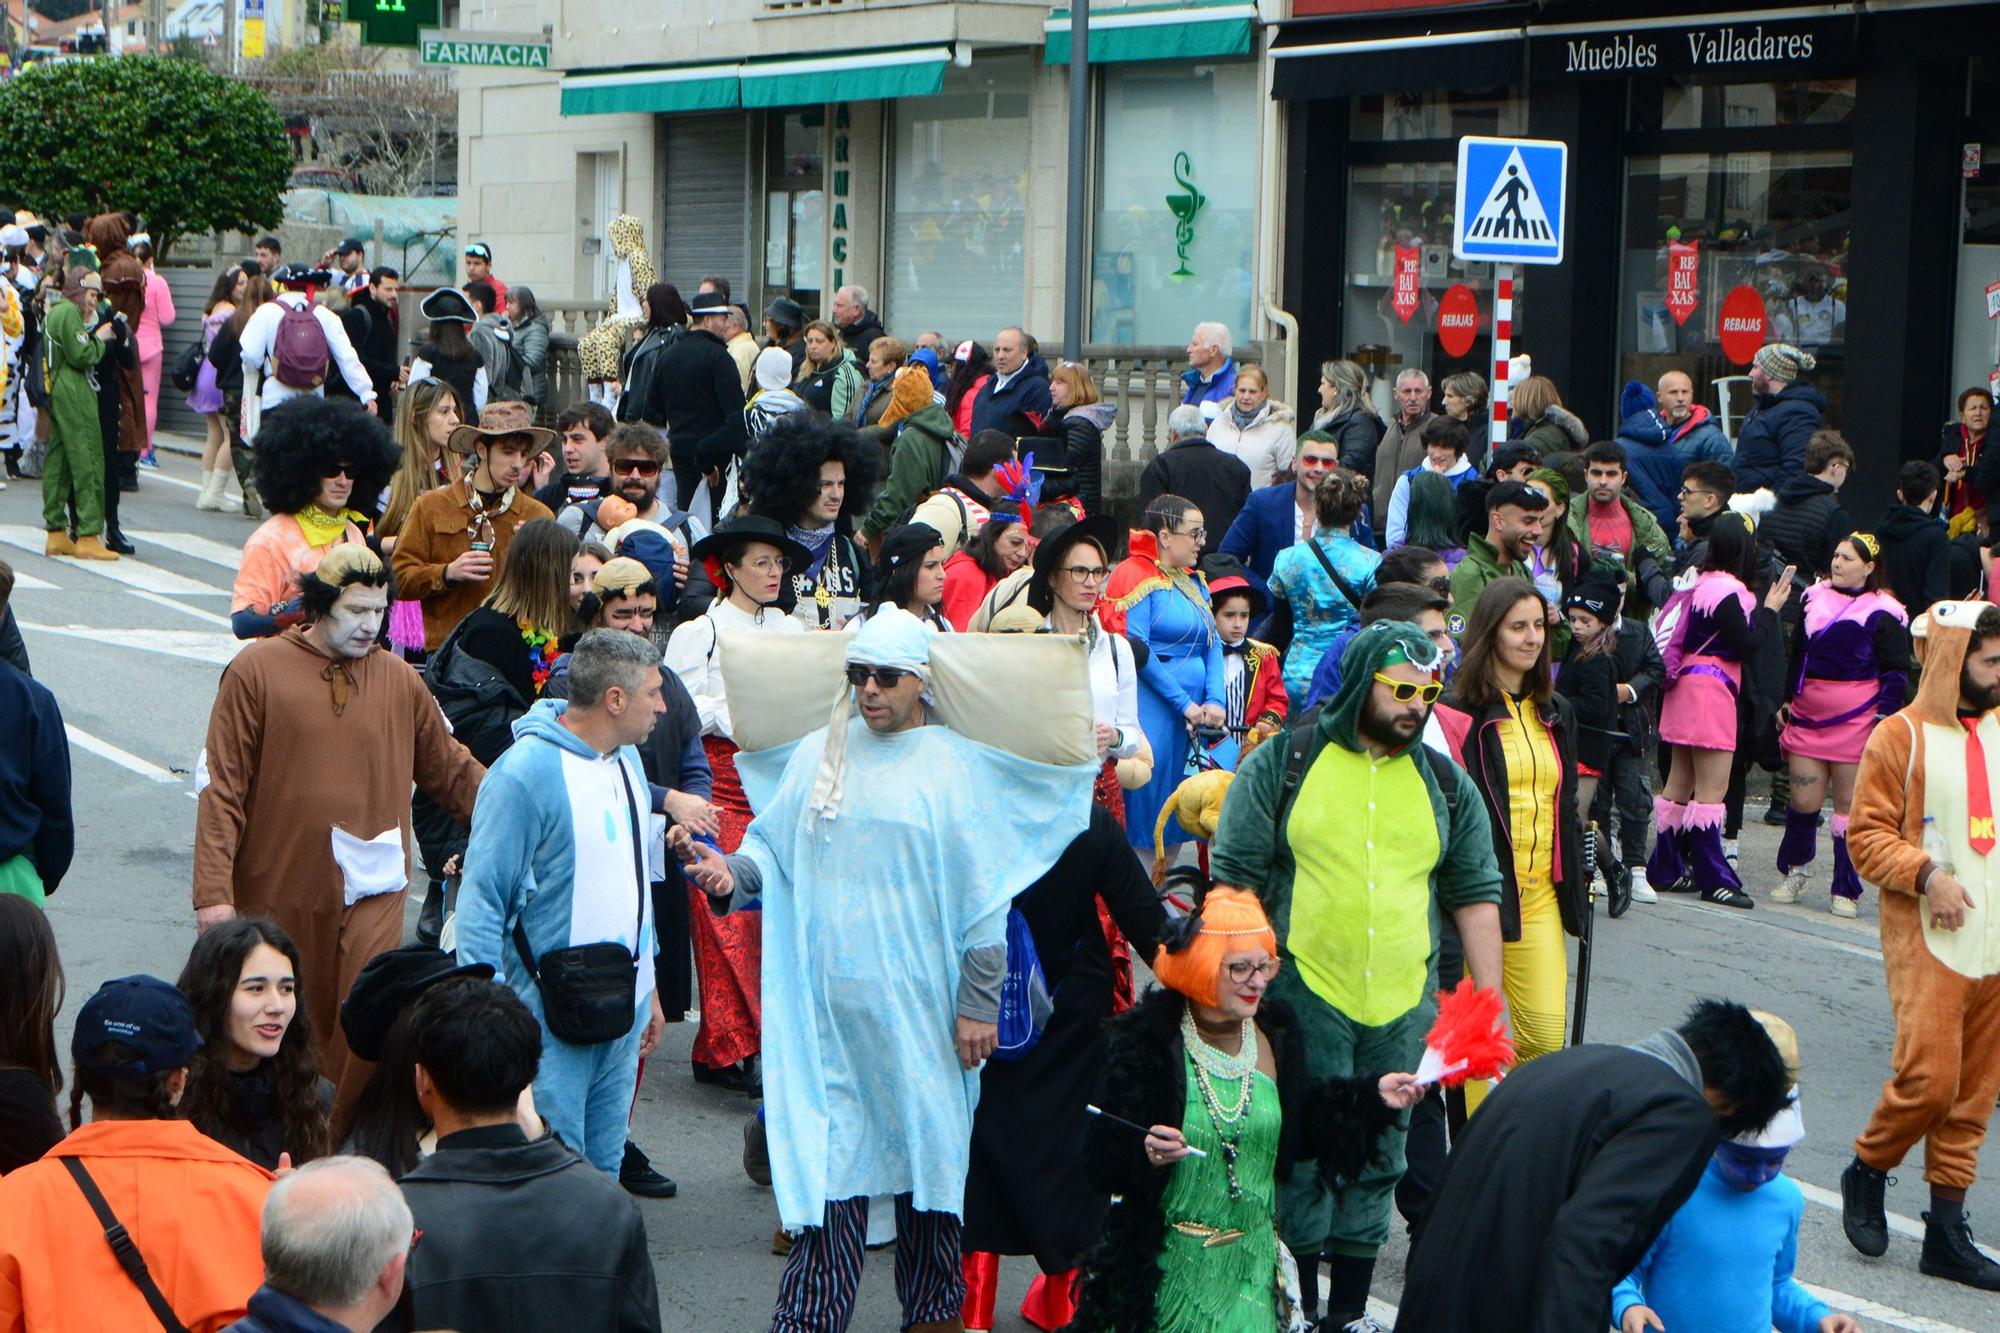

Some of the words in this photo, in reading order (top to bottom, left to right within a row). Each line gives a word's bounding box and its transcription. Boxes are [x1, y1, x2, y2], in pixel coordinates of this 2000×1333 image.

[425, 42, 545, 66] FARMACIA
[1566, 35, 1657, 72] Muebles
[1687, 26, 1813, 64] Valladares
[832, 102, 850, 292] ARMACI
[1404, 260, 1417, 273] RE
[1680, 256, 1695, 270] RE
[1400, 275, 1413, 291] BAI
[1674, 272, 1690, 289] BAI
[1397, 292, 1416, 305] XAS
[1671, 290, 1694, 305] XAS
[1442, 314, 1474, 327] REBAJAS
[1724, 318, 1761, 332] REBAJAS
